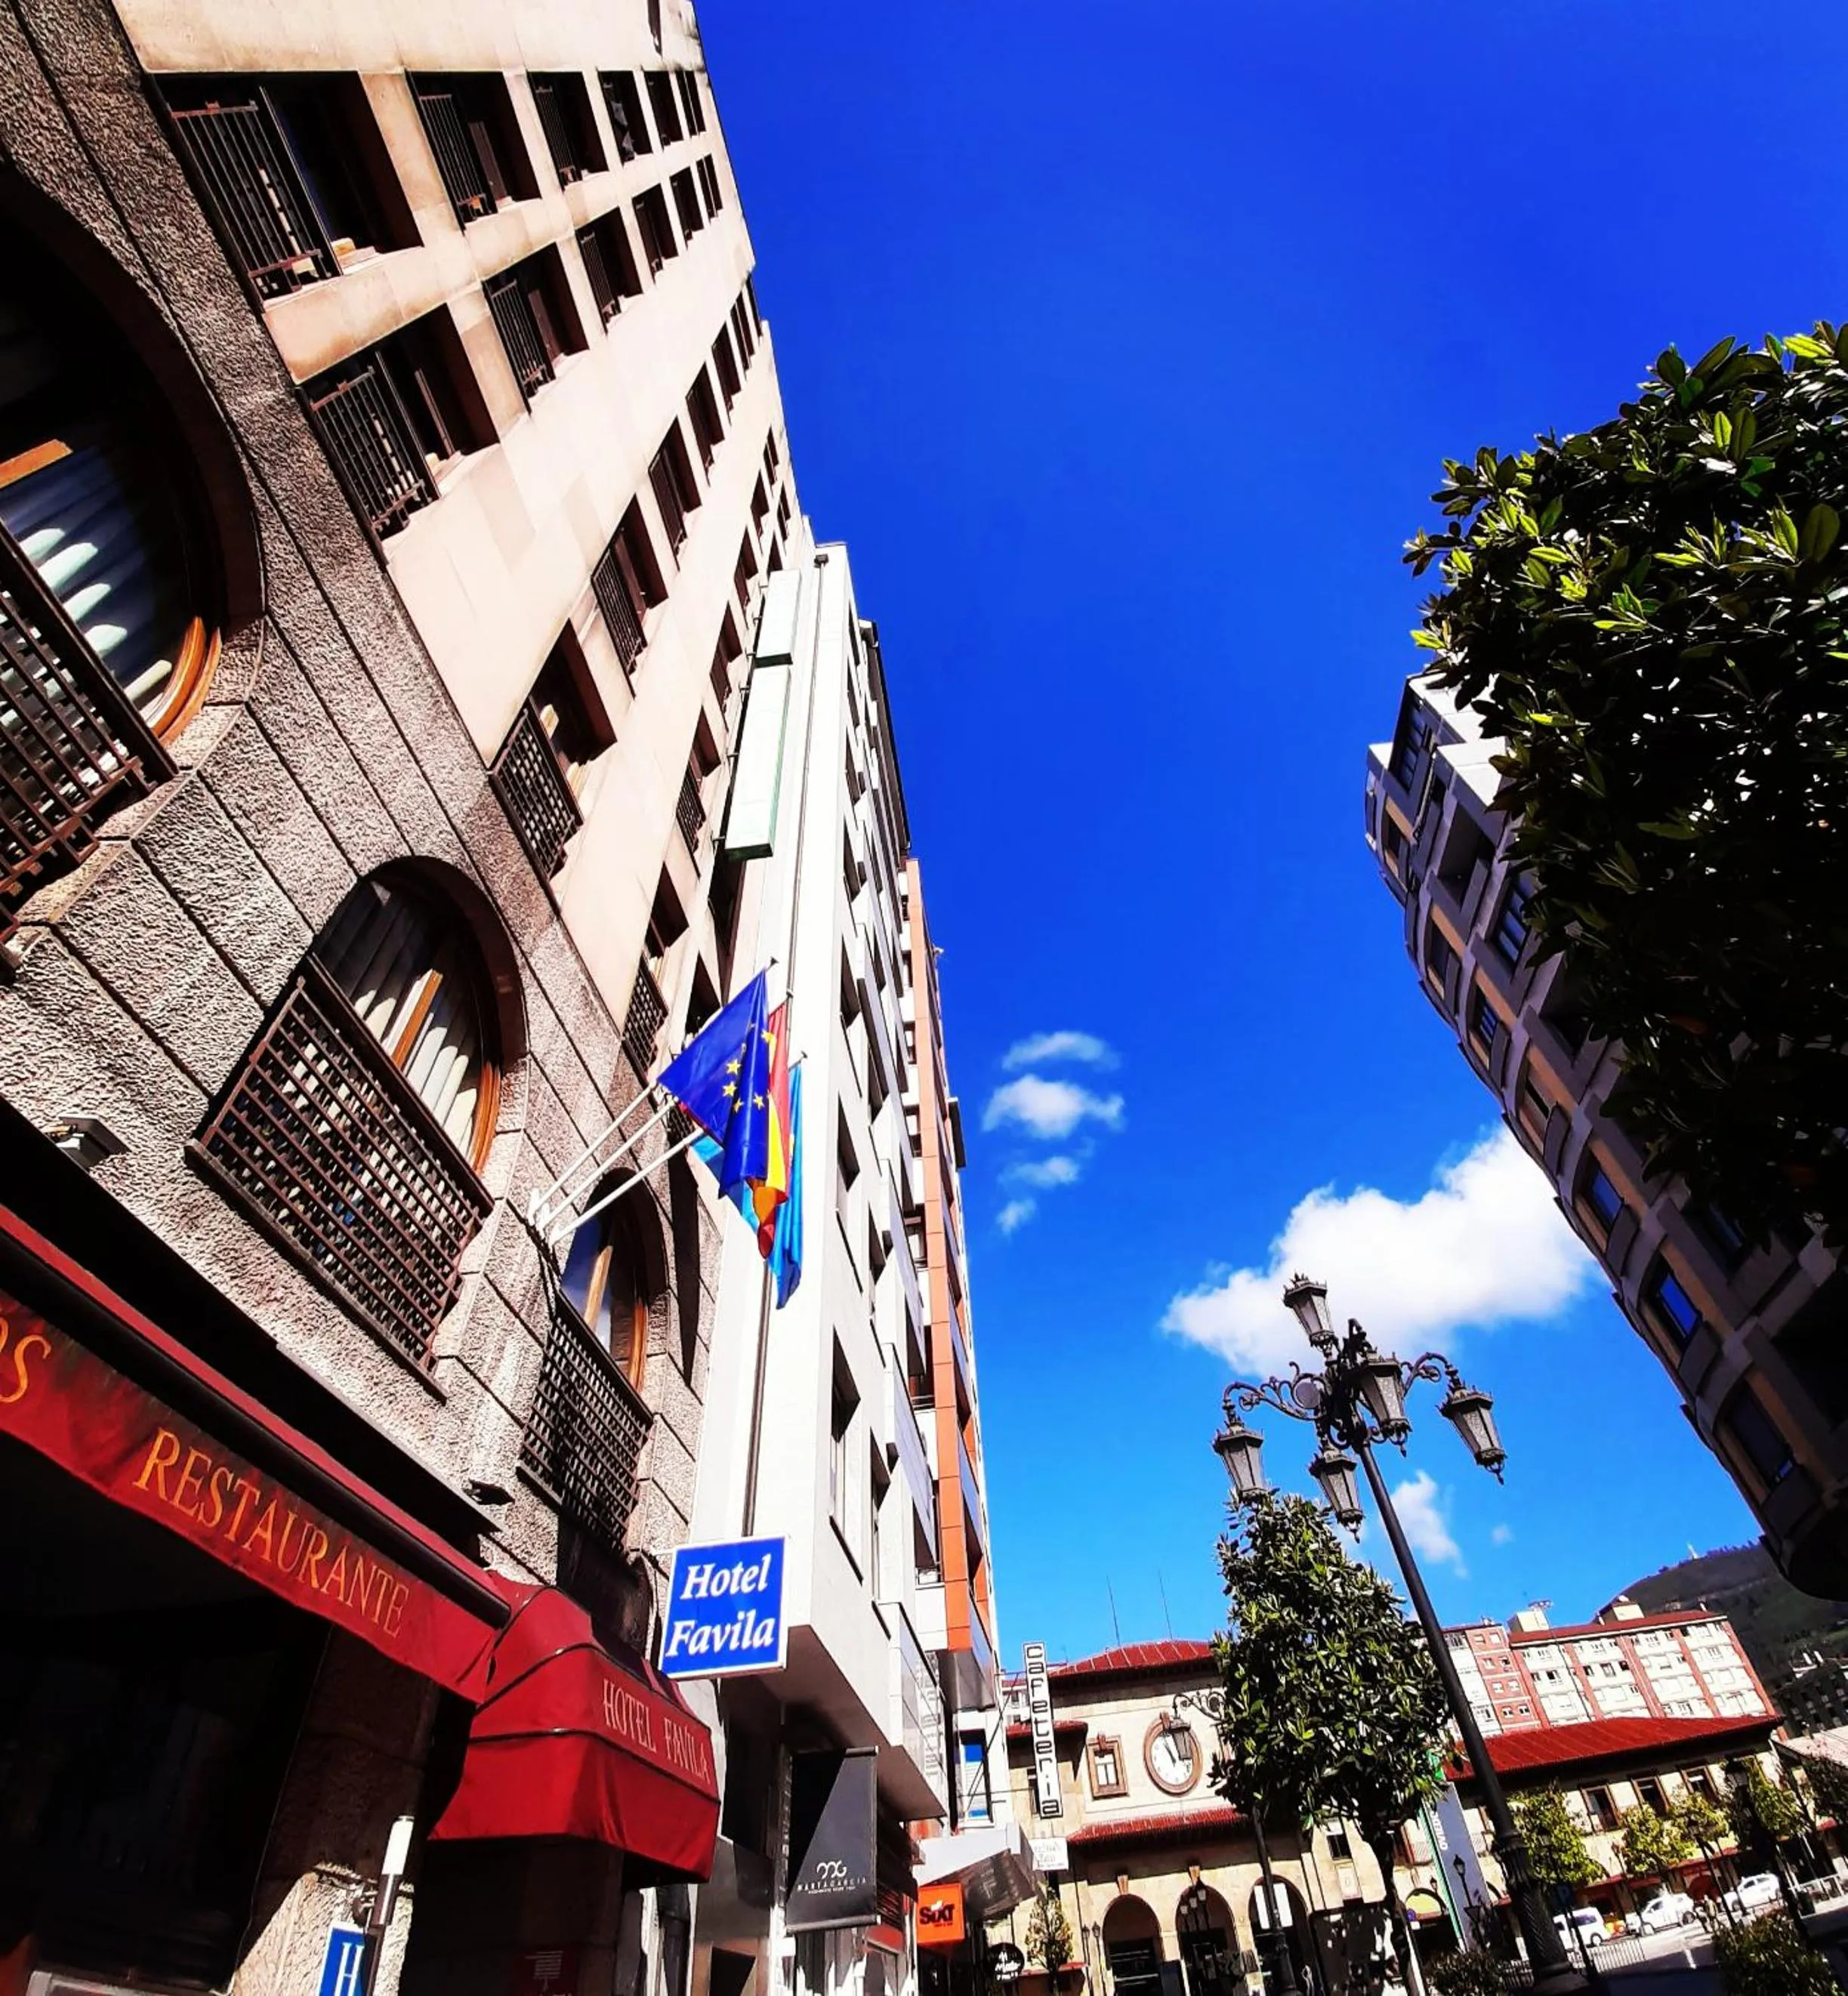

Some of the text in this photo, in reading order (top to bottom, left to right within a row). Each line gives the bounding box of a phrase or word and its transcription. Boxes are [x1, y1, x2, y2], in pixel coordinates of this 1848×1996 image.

[133, 1427, 409, 1639] RESTAURANTE
[679, 1553, 772, 1600] Hotel
[665, 1609, 776, 1658] Favila
[603, 1679, 711, 1785] HOTEL FAVILA
